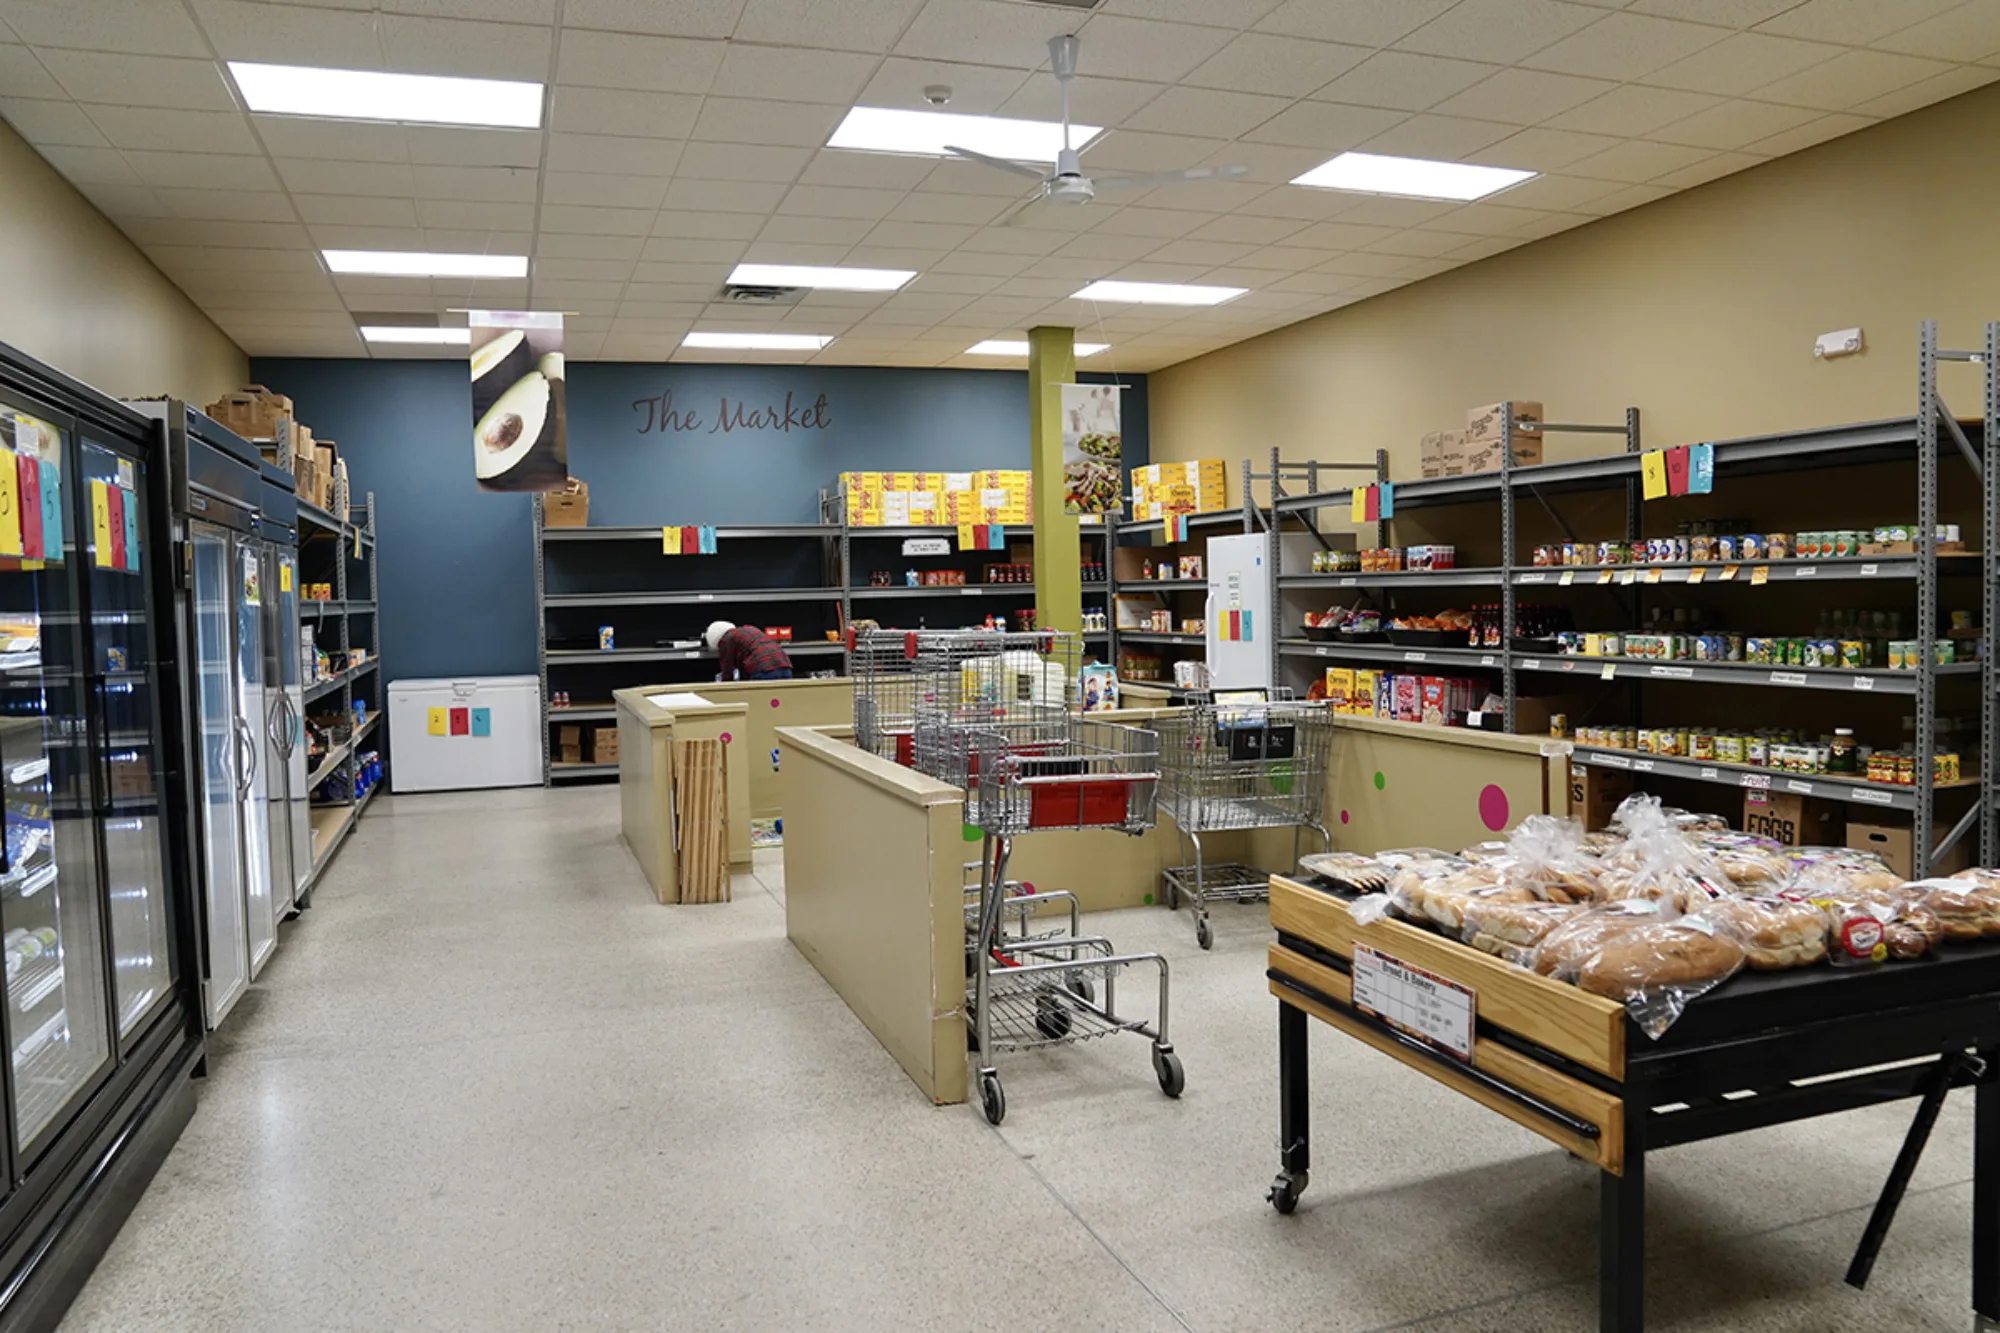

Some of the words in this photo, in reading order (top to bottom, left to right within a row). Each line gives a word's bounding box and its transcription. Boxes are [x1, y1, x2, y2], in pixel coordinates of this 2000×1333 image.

[632, 389, 702, 434] The
[708, 391, 832, 434] Market
[46, 490, 54, 520] 5
[98, 504, 105, 529] 2
[1748, 814, 1794, 845] EGGS
[1382, 960, 1402, 979] Bread
